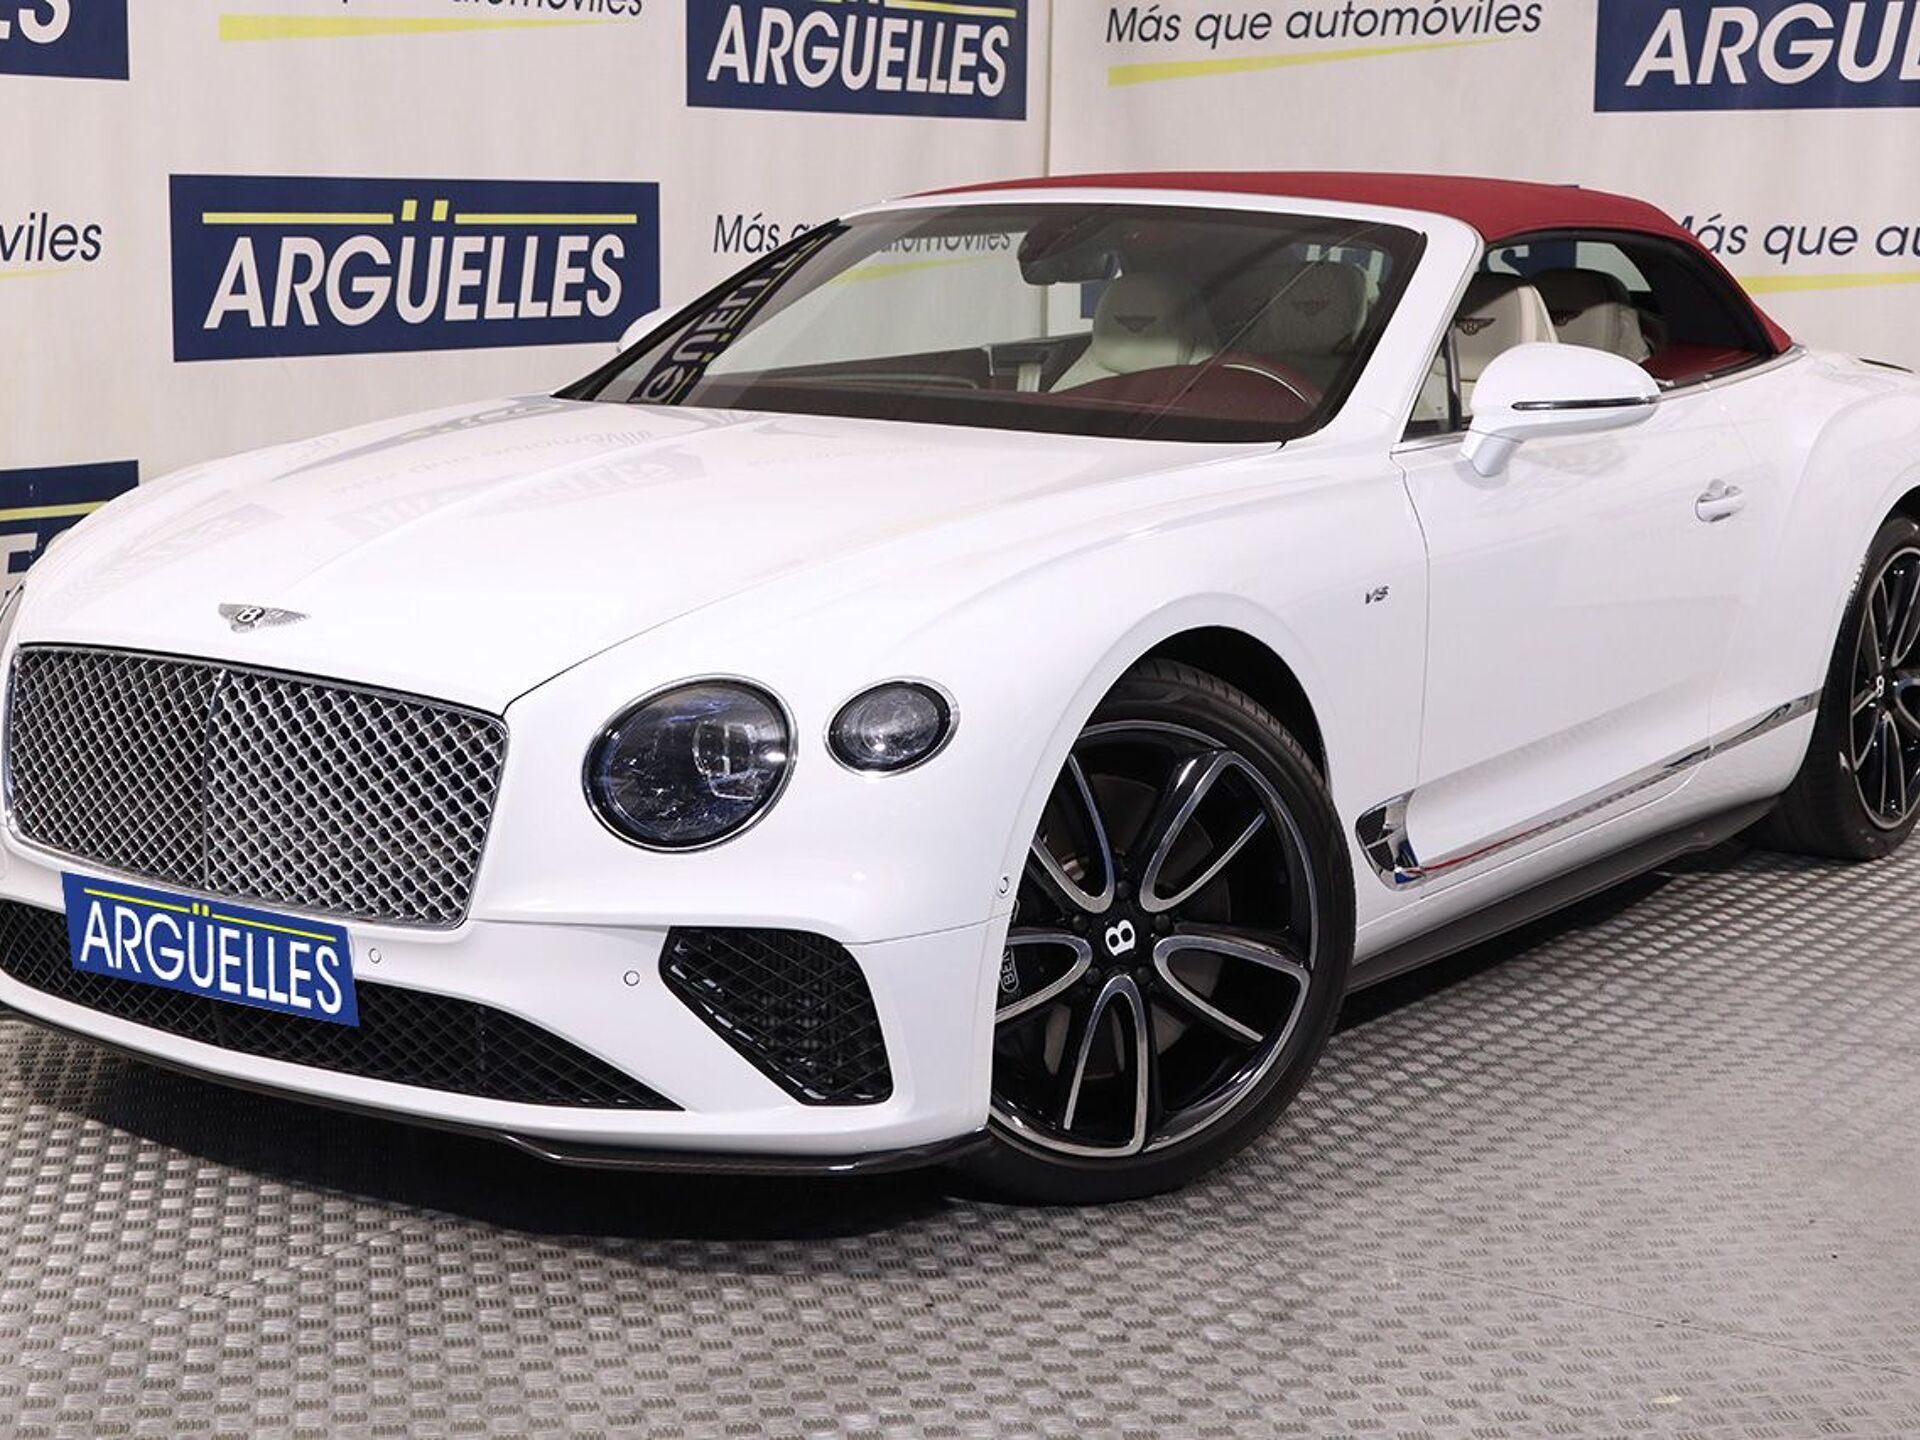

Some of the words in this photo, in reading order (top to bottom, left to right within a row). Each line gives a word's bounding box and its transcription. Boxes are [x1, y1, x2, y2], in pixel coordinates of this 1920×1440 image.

[1106, 7, 1181, 43] Más
[1195, 17, 1272, 49] que
[1285, 0, 1542, 38] automóviles
[0, 212, 102, 262] viles
[713, 212, 780, 253] Más
[1764, 225, 1858, 264] que
[203, 199, 626, 329] ARGÜELLES
[1105, 919, 1136, 956] B
